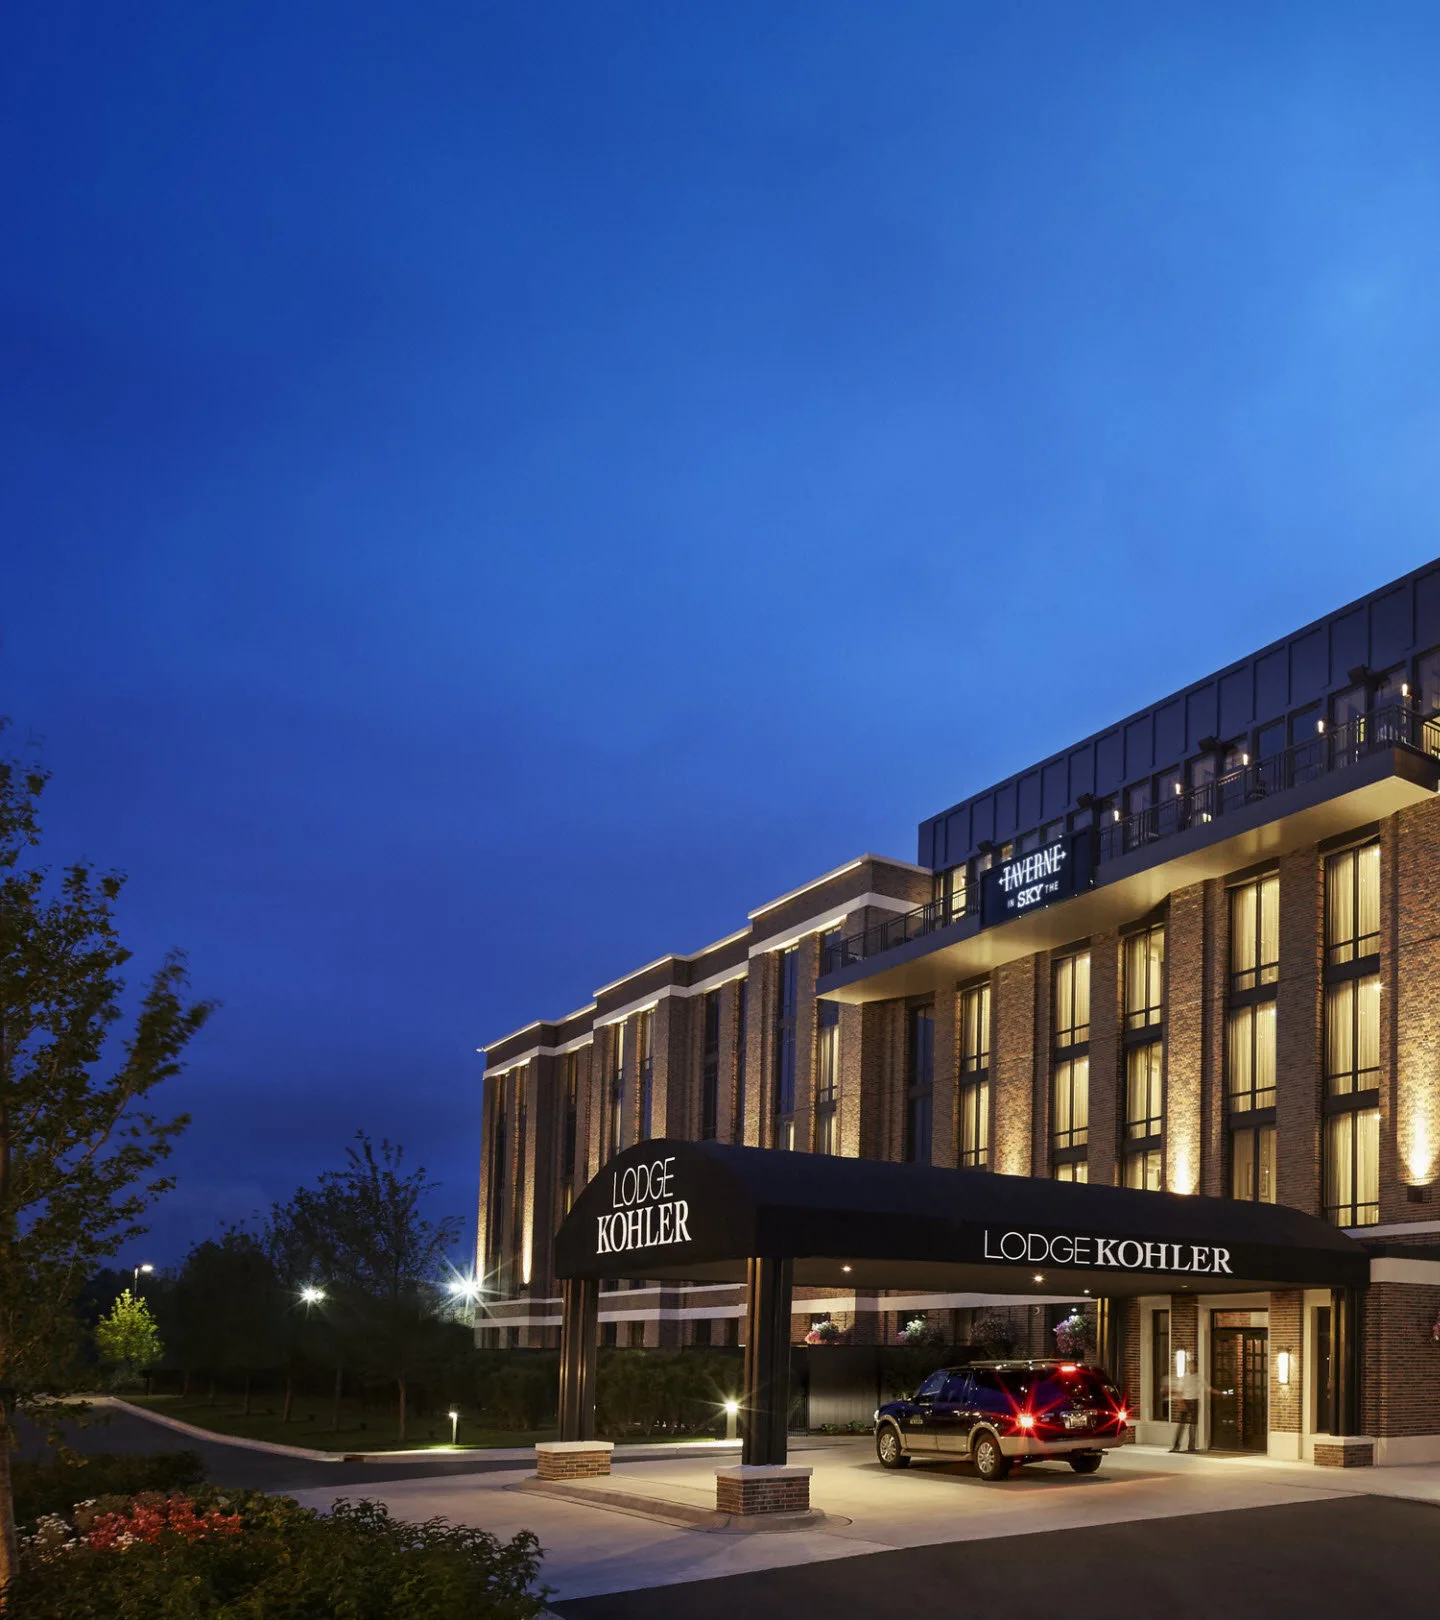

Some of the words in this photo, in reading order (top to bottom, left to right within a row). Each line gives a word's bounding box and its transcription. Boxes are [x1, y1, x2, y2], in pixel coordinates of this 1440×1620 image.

[999, 844, 1067, 892] TAVERNE
[1017, 883, 1044, 907] SKY
[1045, 881, 1059, 894] THE
[612, 1157, 676, 1208] LODGE
[596, 1200, 692, 1254] KOHLER
